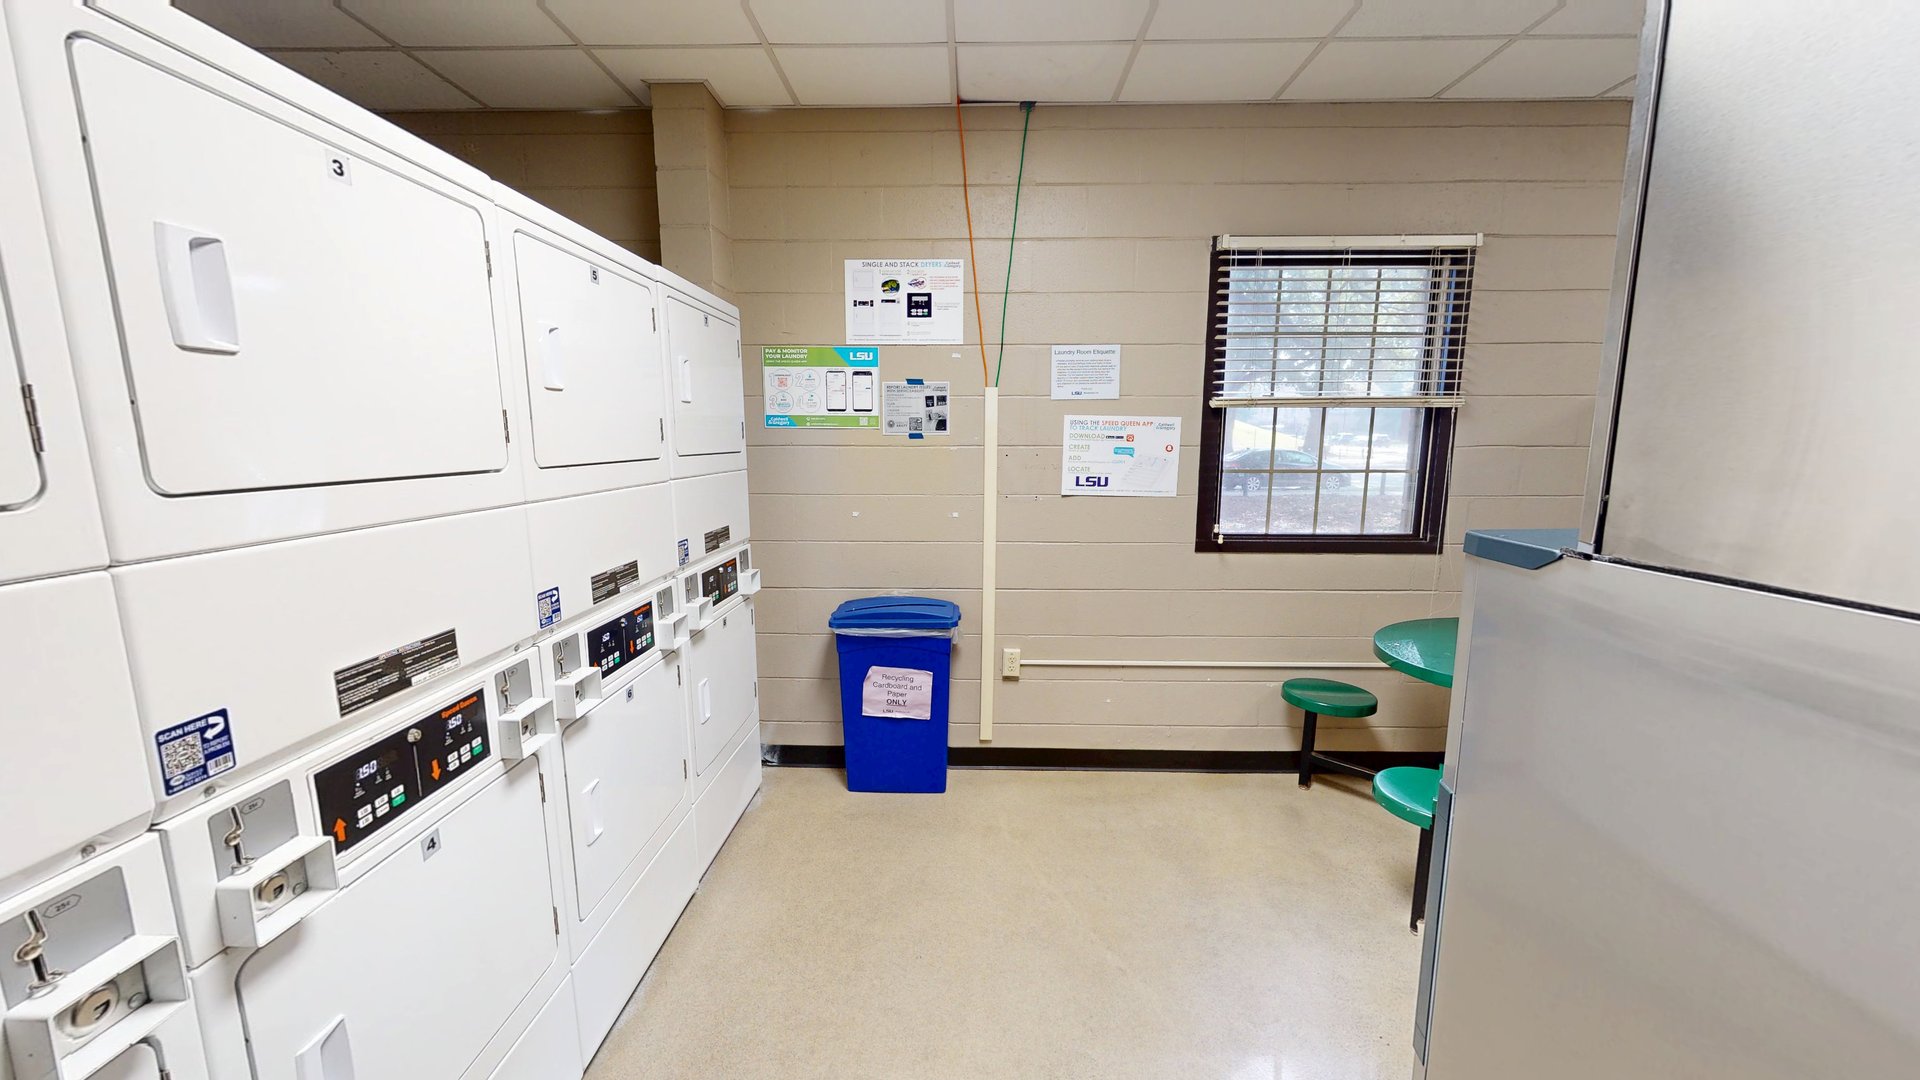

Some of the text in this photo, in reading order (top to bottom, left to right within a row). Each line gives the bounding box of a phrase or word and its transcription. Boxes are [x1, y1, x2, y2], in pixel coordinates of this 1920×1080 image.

[332, 158, 344, 176] 3
[593, 270, 597, 280] 5
[849, 352, 873, 360] LSU
[1076, 476, 1108, 487] LSU
[882, 674, 914, 683] Recycling
[873, 681, 908, 690] Cardboard
[628, 689, 632, 698] 6
[158, 718, 208, 743] SCAN HERE
[427, 837, 436, 851] 4
